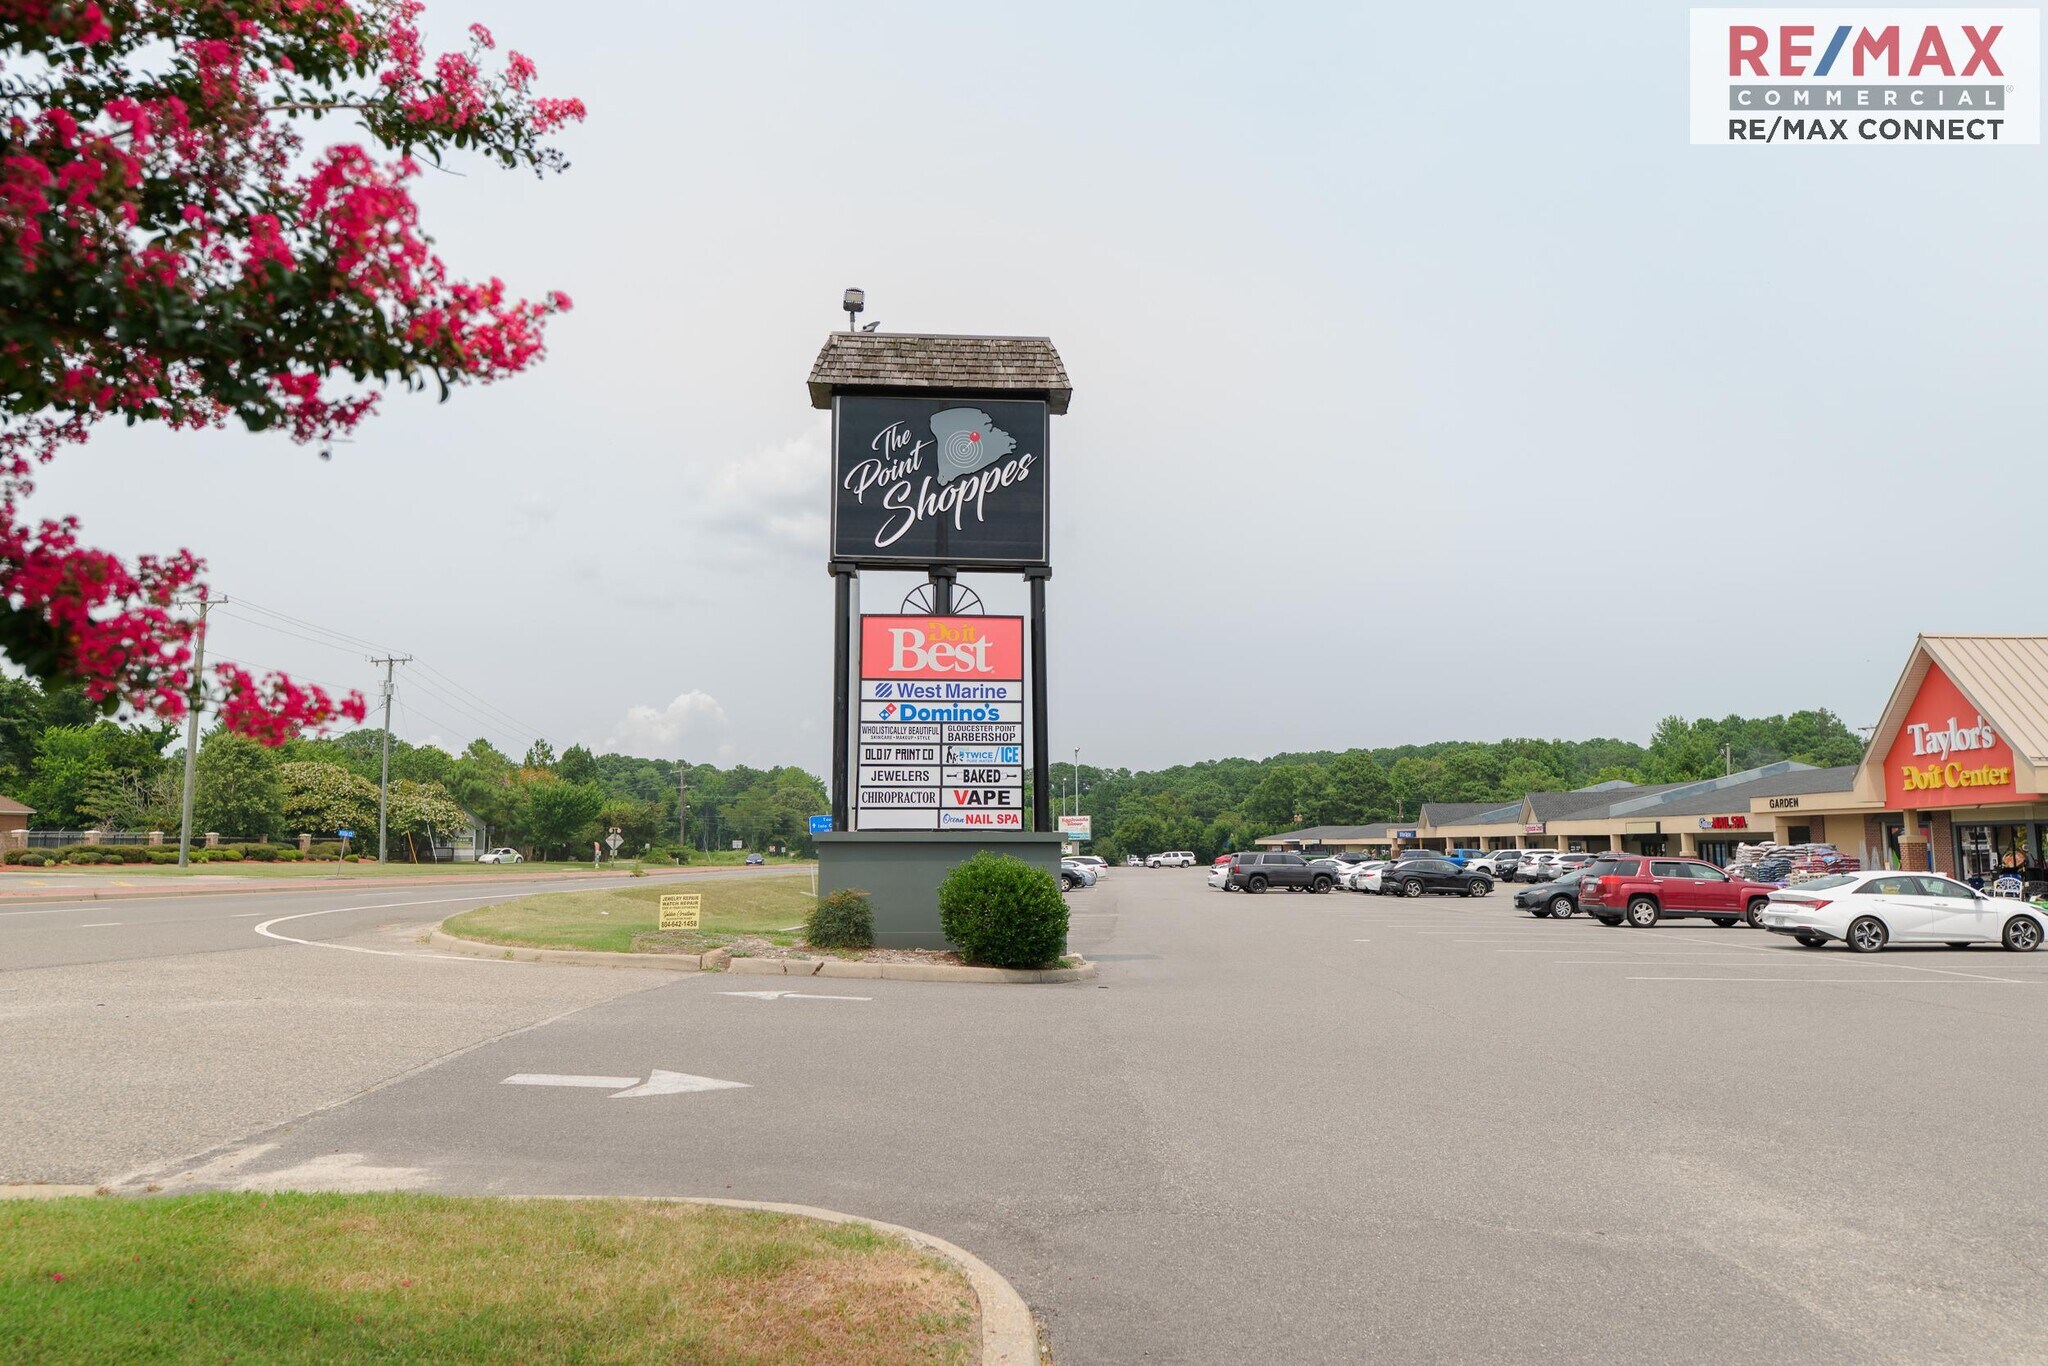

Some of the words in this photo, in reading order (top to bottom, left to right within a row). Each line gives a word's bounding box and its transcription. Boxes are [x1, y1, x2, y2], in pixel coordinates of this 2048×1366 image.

[871, 420, 912, 461] The
[843, 439, 936, 504] Point
[874, 453, 1038, 548] Shoppes
[888, 627, 994, 673] Best
[897, 683, 942, 699] West
[945, 683, 1007, 699] Marine
[900, 702, 1000, 721] Domino's
[861, 725, 908, 735] WHOLISTICALLY
[908, 725, 940, 735] BEAUTIFUL
[947, 732, 1016, 742] BARBERSHOP
[1907, 715, 1997, 761] Taylor's
[865, 748, 883, 761] OLD
[895, 748, 921, 761] PRINT
[922, 748, 934, 761] CO
[965, 751, 994, 759] TWICE
[1000, 746, 1019, 763] ICE
[870, 770, 930, 782] JEWELERS
[963, 769, 1001, 783] BAKED
[1945, 762, 2012, 788] Center
[861, 791, 936, 804] CHIROPRACTOR
[953, 789, 1011, 806] VAPE
[1769, 797, 1799, 809] GARDEN
[965, 813, 994, 825] NAIL
[996, 813, 1019, 825] SPA
